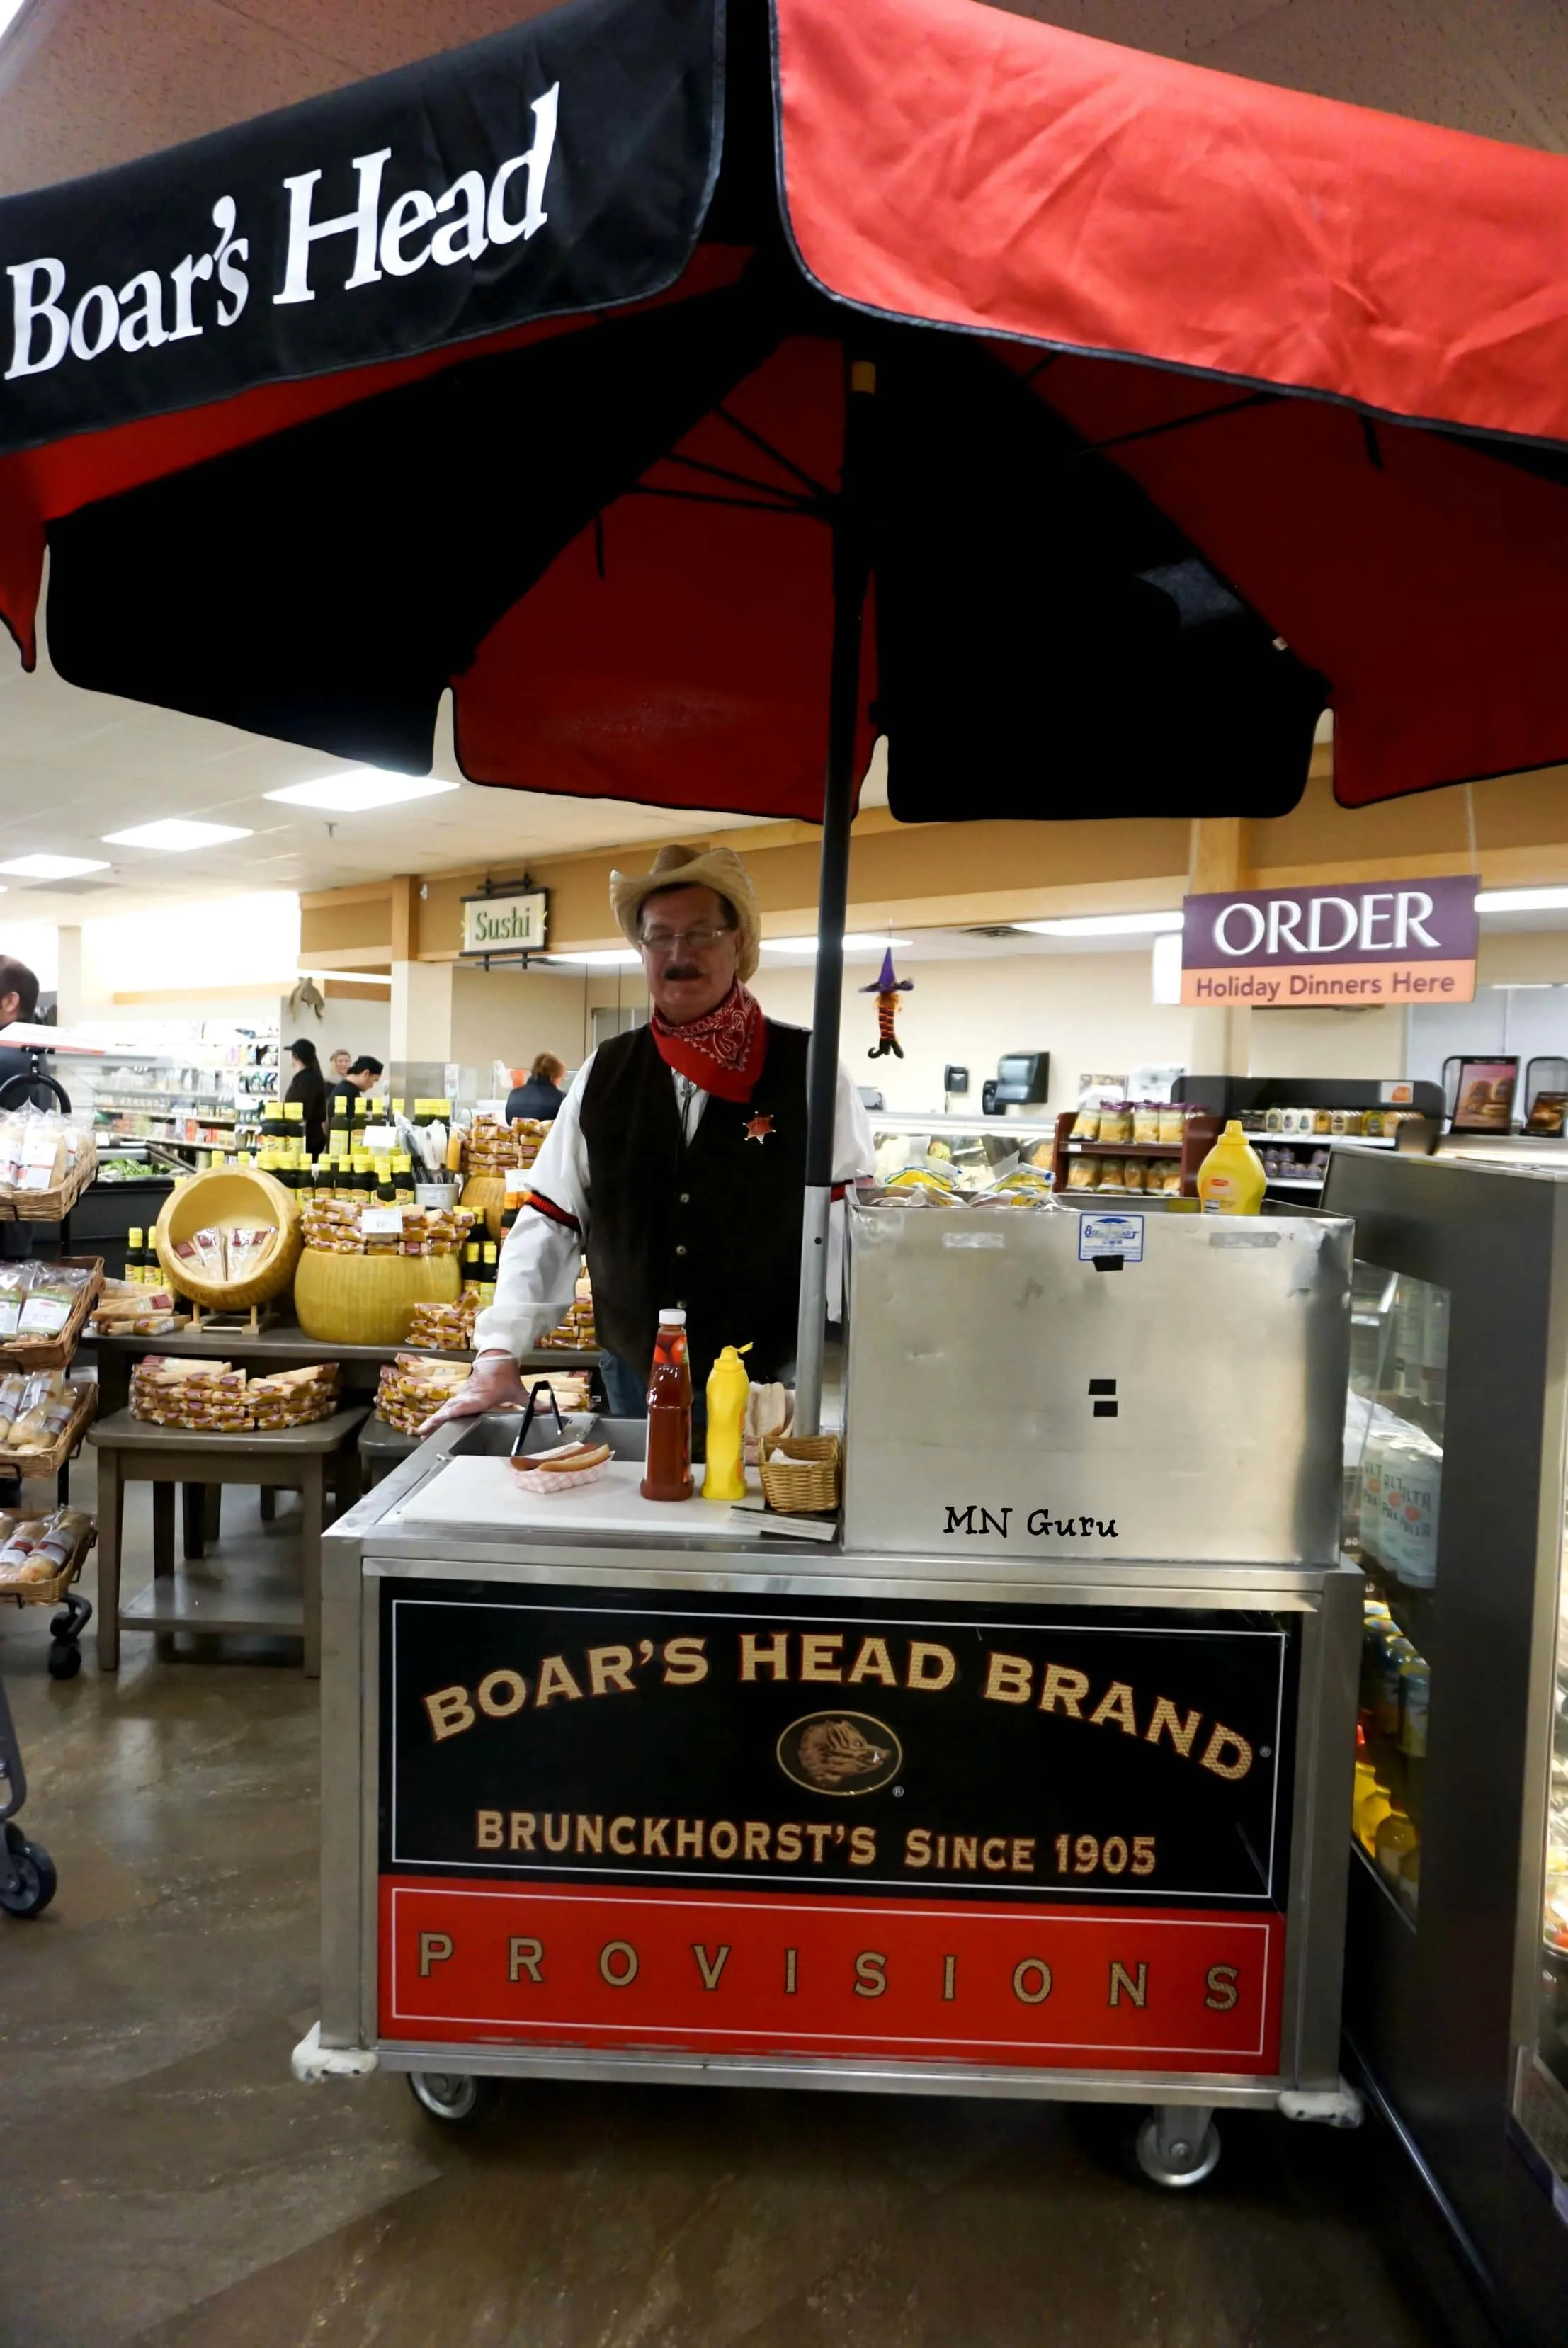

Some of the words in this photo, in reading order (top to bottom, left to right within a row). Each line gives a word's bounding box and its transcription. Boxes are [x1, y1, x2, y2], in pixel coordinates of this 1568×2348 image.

[4, 195, 249, 380] Boar's
[272, 81, 560, 305] Head
[475, 907, 530, 941] Sushi
[1213, 891, 1442, 956] ORDER
[1196, 975, 1281, 1003] Holiday
[1290, 974, 1383, 996] Dinners
[1392, 971, 1455, 994] Here
[424, 1637, 709, 1744] BOAR'S
[739, 1632, 957, 1691] HEAD
[982, 1650, 1254, 1781] BRAND
[476, 1809, 877, 1866] BRUNCKHORST'S
[904, 1827, 1036, 1873] SINCE
[1055, 1832, 1157, 1876] 1905
[418, 1932, 1239, 2012] PROVISIONS
